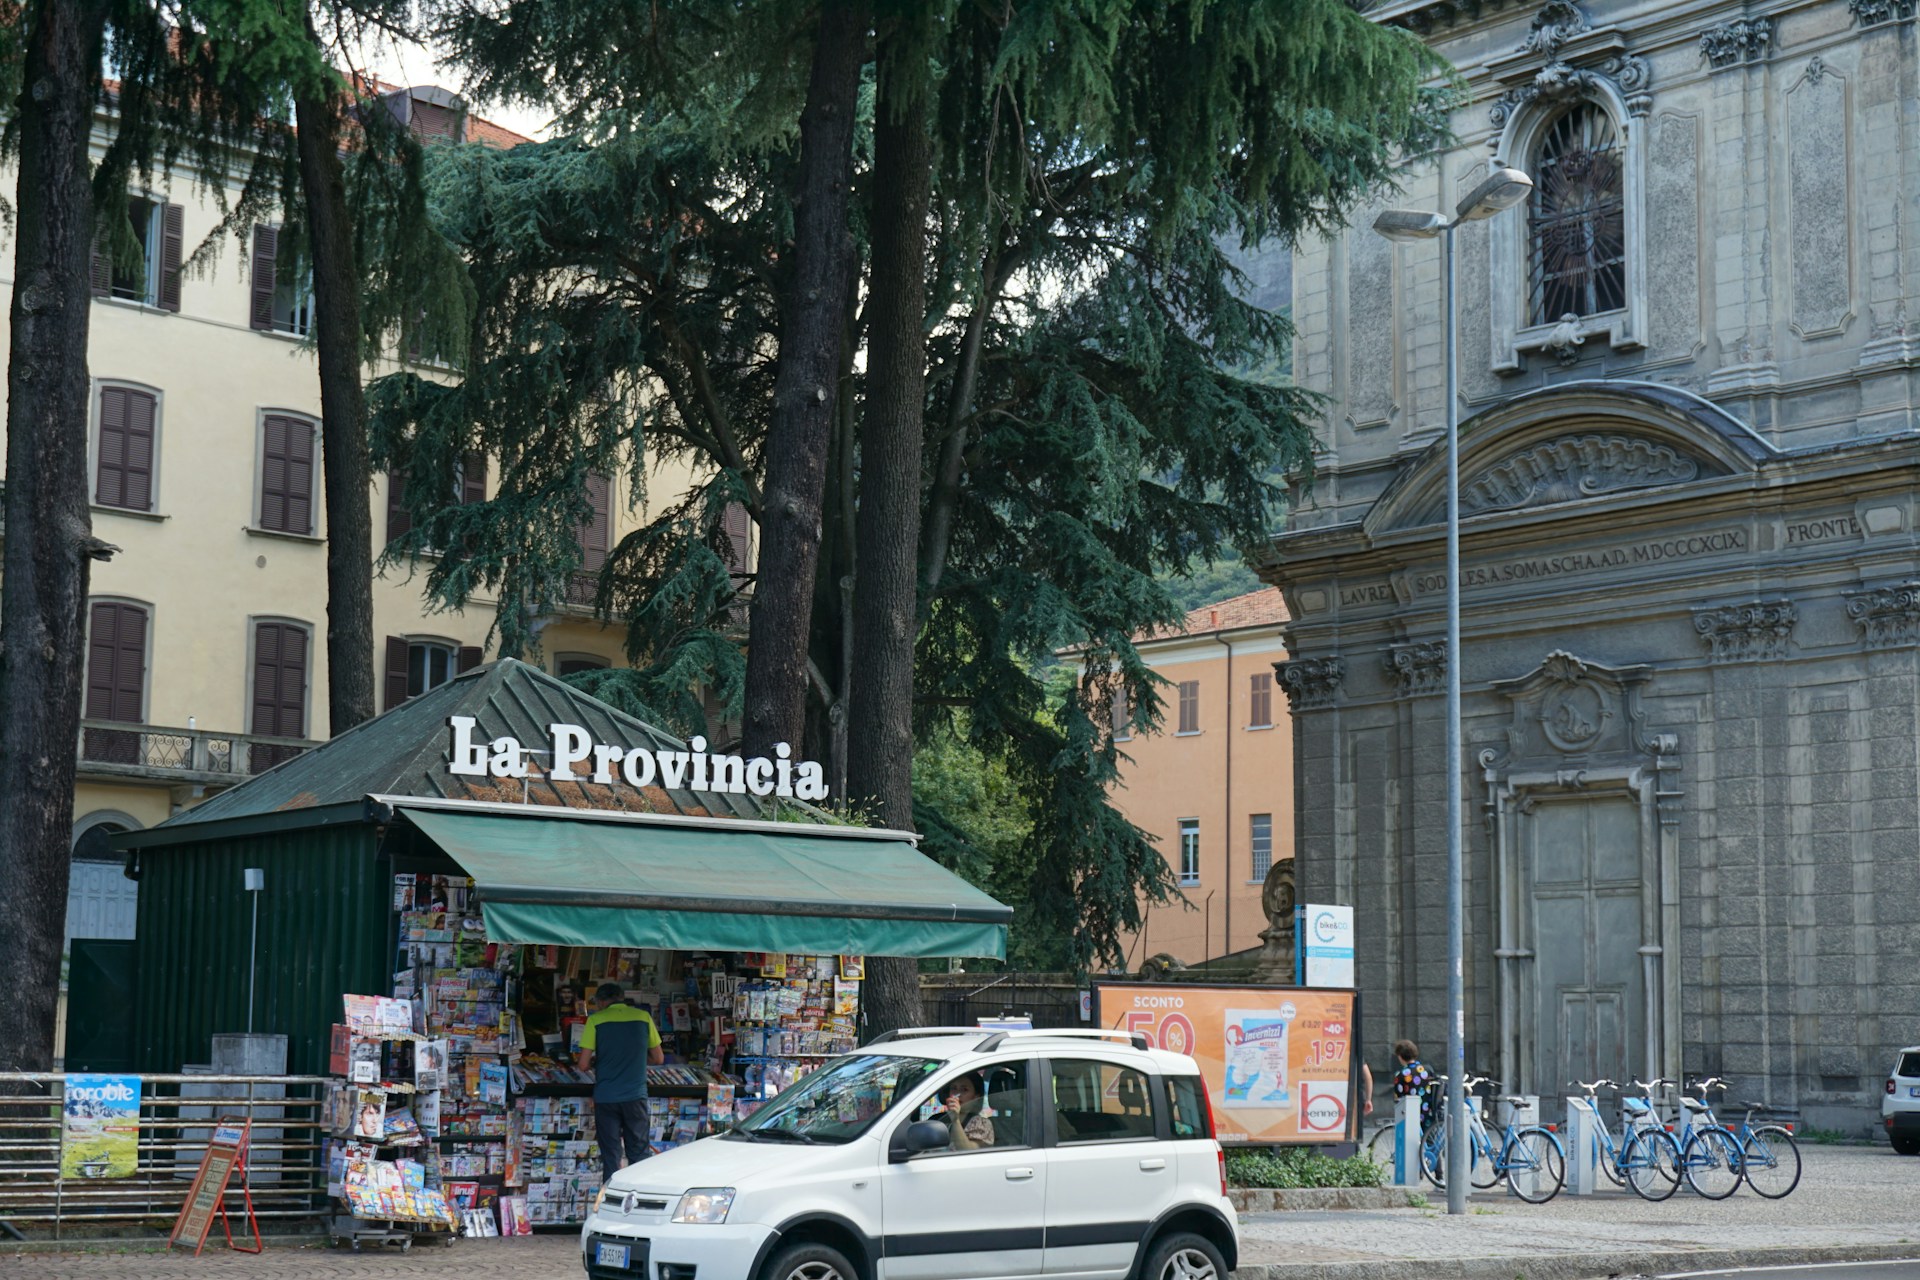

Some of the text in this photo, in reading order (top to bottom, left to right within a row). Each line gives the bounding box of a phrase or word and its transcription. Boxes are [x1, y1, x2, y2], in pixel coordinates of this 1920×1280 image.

[1786, 516, 1862, 543] FRONTE
[447, 715, 829, 800] La Provincia
[1134, 995, 1184, 1009] SCONTO
